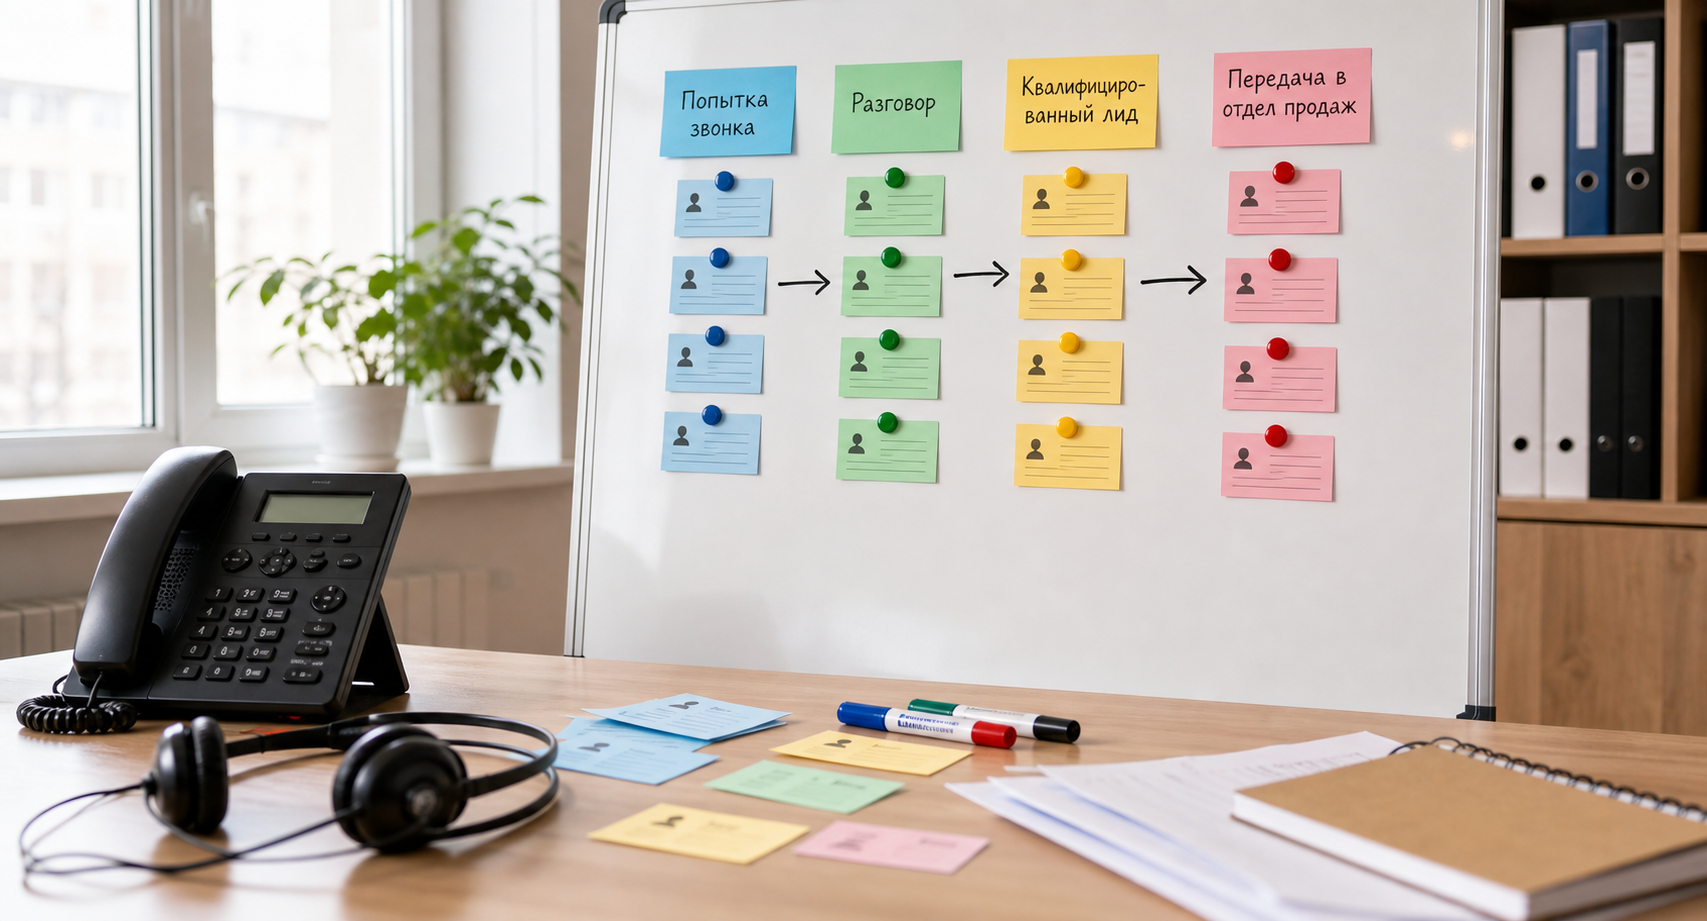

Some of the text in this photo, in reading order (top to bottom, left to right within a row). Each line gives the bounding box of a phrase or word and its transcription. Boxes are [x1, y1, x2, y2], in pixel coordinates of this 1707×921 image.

[1022, 75, 1146, 101] Квалифициро-
[1228, 68, 1347, 95] Передача в
[681, 90, 769, 110] Попытка
[852, 91, 936, 118] Разговор
[1222, 100, 1357, 123] отдел продаж
[1025, 103, 1139, 126] ванный лид
[690, 122, 755, 138] звонка
